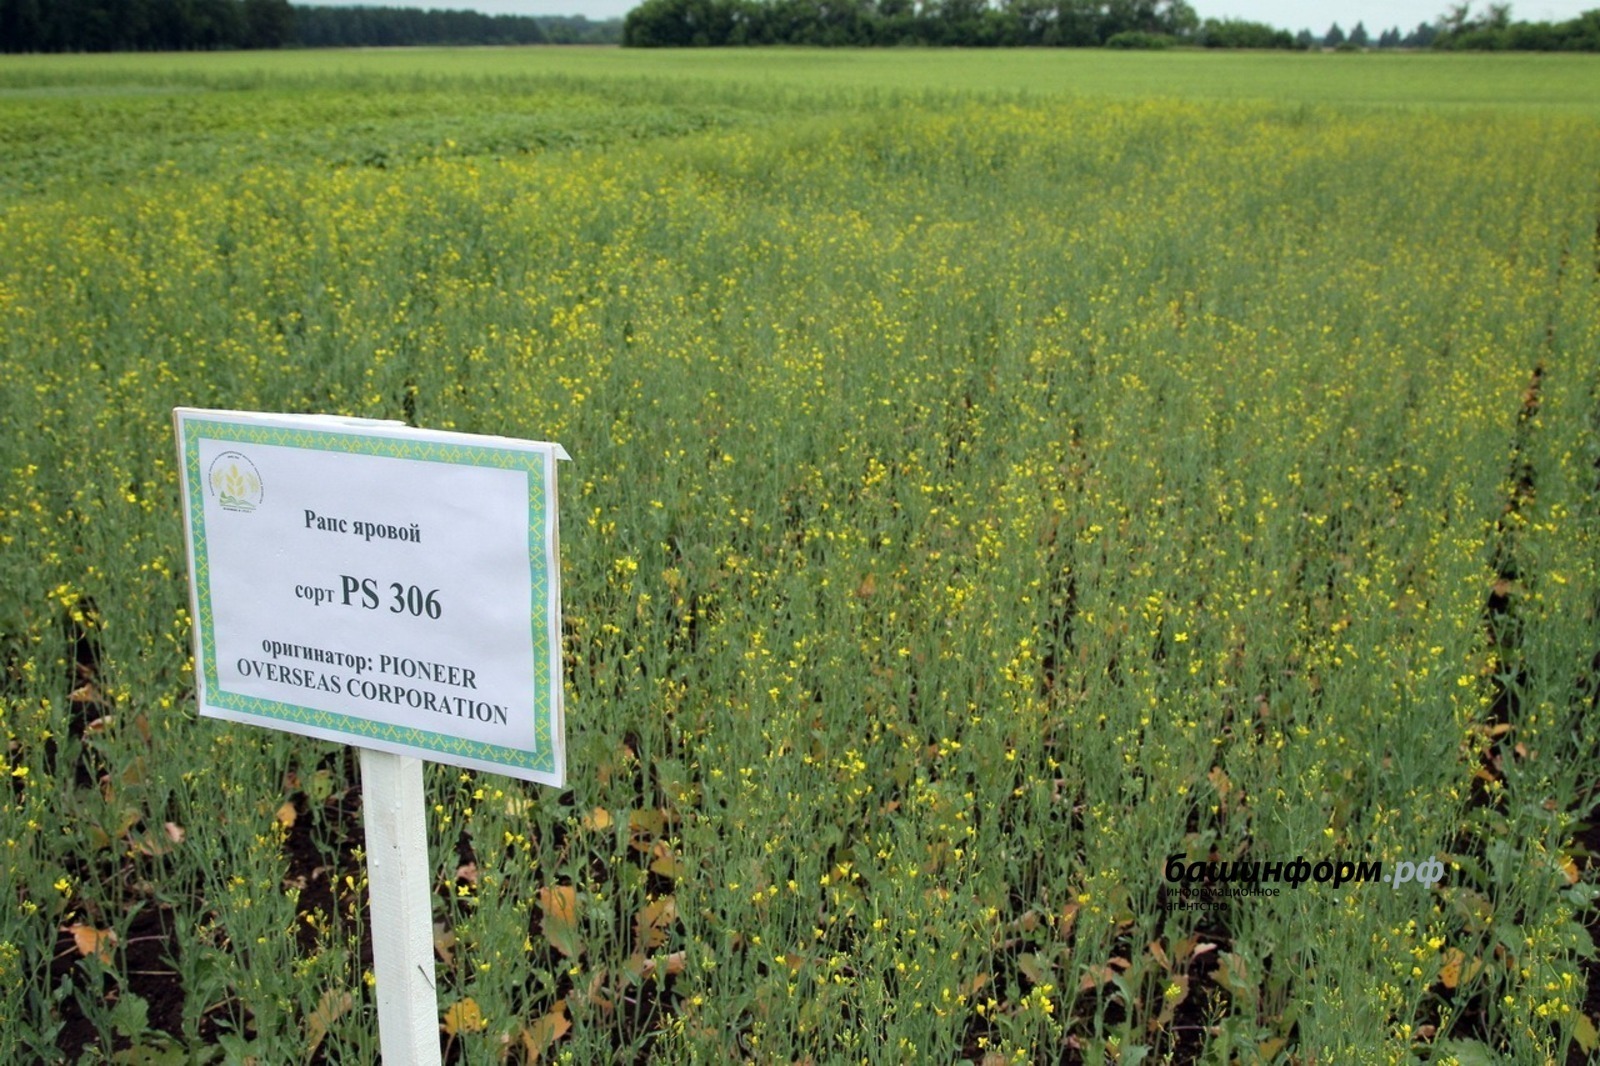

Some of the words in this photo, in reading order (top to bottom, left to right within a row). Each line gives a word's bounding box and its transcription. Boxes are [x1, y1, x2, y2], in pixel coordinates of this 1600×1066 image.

[304, 509, 348, 535] Рапс
[353, 521, 421, 544] яровой
[295, 581, 335, 604] сорт
[339, 575, 380, 609] PS
[390, 582, 442, 620] 306
[262, 638, 373, 674] оригинатор:
[379, 654, 476, 690] PIONEER
[237, 657, 341, 694] OVERSEAS
[347, 679, 508, 725] CORPORATION
